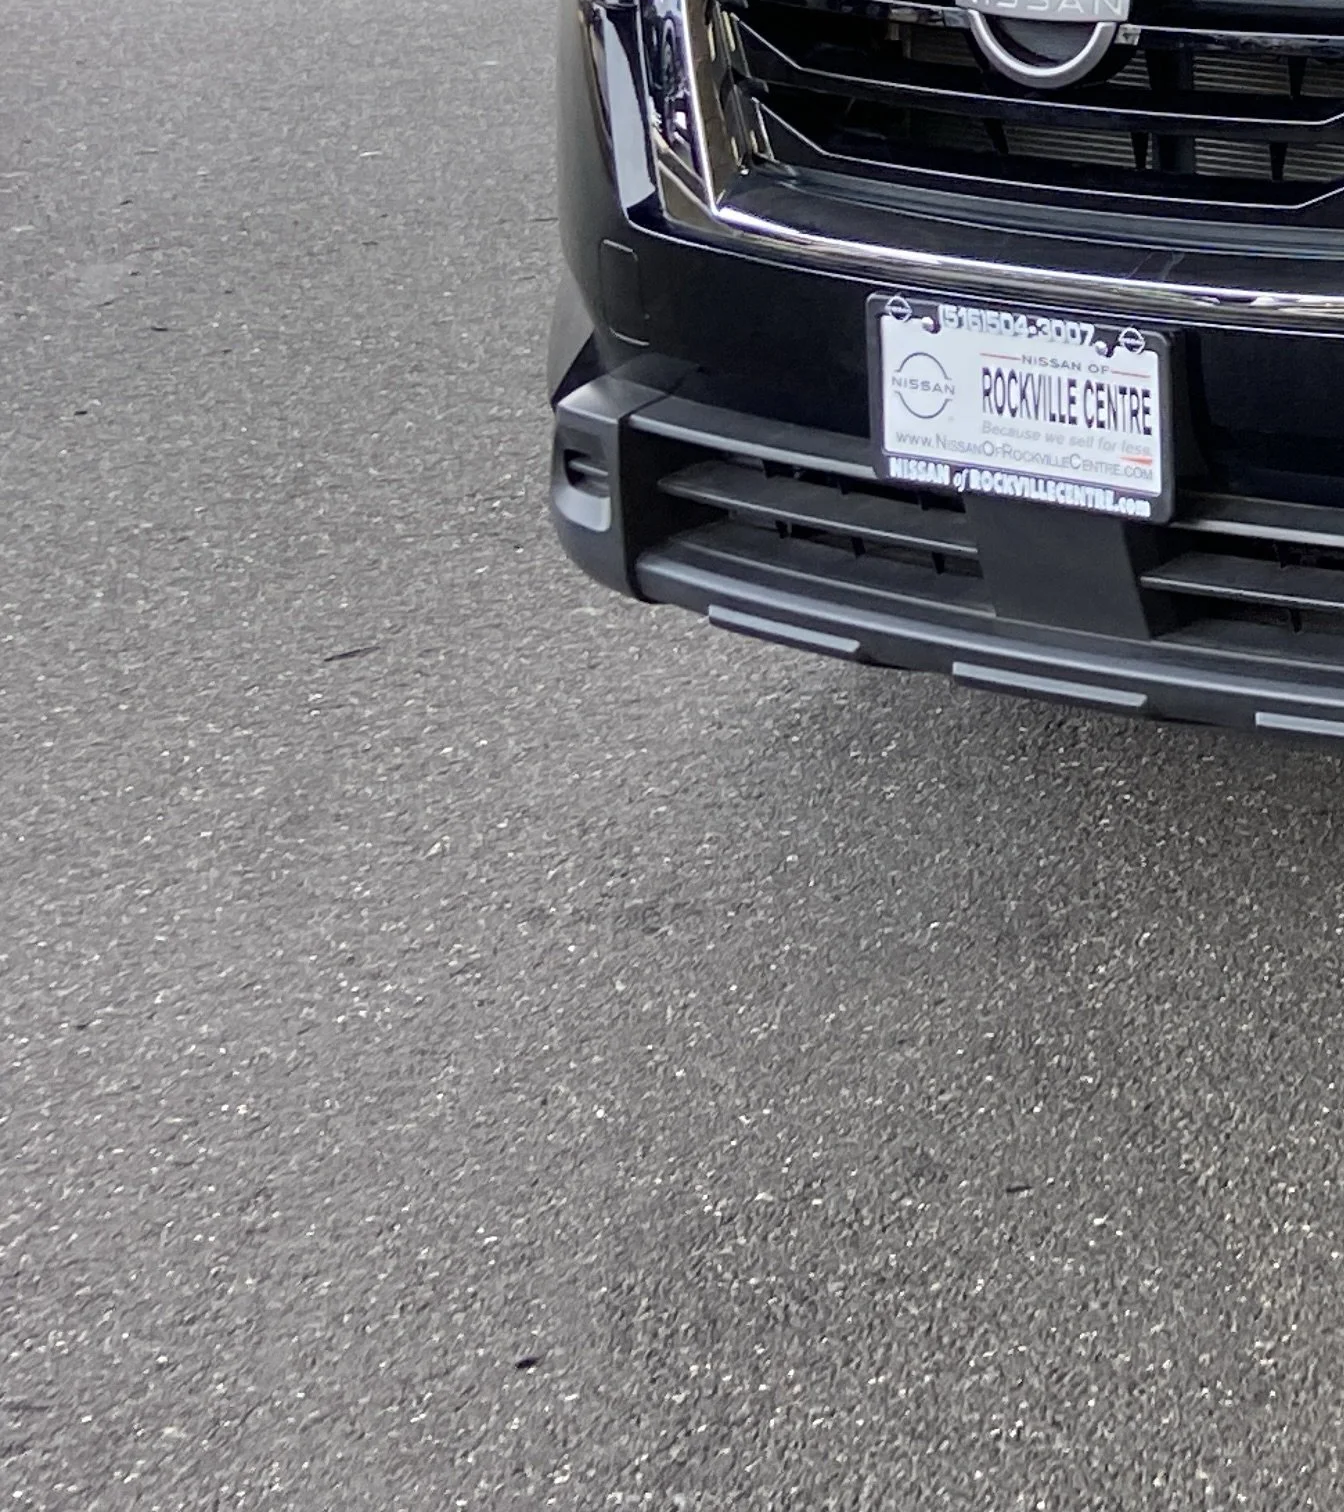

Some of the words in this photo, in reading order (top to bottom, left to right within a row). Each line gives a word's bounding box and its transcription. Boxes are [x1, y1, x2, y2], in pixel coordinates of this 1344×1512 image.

[1021, 354, 1082, 372] NISSAN
[1087, 363, 1110, 374] OF
[891, 376, 955, 395] NISSAN
[982, 367, 1078, 426] ROCKVILLE
[1083, 379, 1152, 436] CENTRE
[982, 420, 1041, 441] Because
[1045, 433, 1065, 446] we
[1068, 431, 1093, 448] sell
[1096, 435, 1118, 452] for
[889, 457, 950, 485] NISSAN
[953, 469, 969, 492] of
